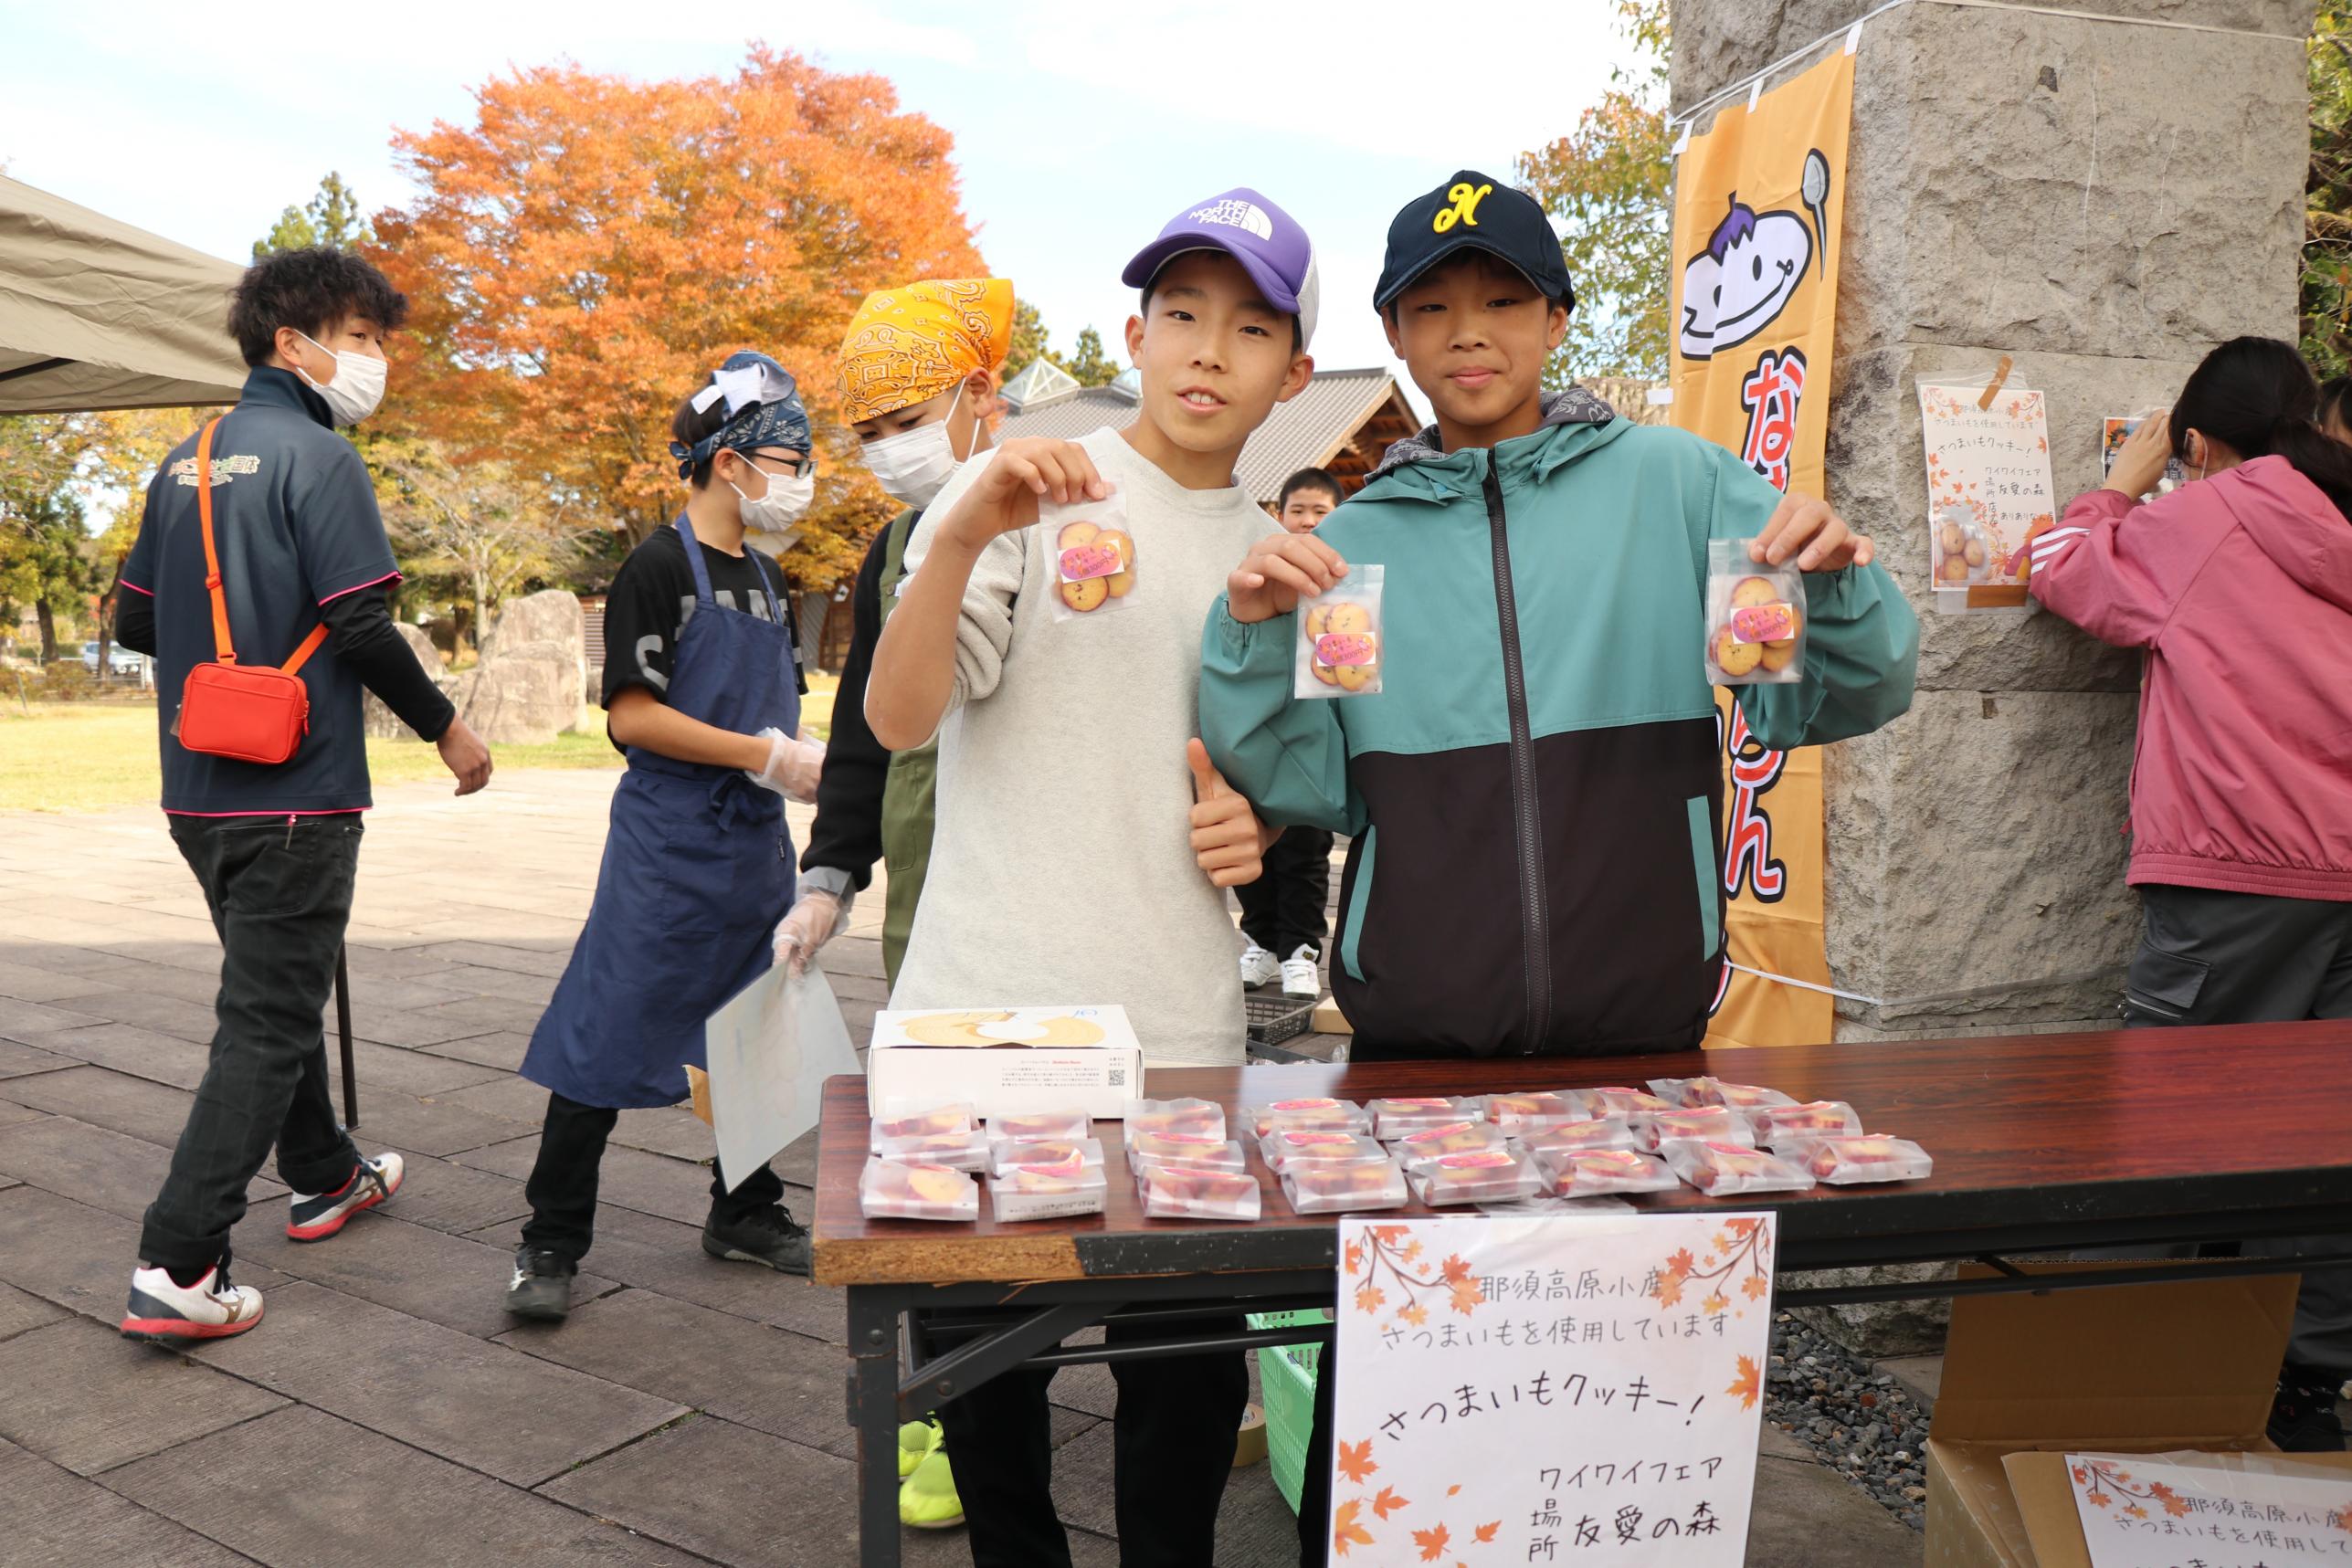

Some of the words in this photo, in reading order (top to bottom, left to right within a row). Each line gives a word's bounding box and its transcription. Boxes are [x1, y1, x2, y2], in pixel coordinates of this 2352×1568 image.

[1188, 206, 1248, 221] NORTH
[1198, 216, 1240, 227] FACE
[1218, 199, 1250, 211] THE
[1480, 1266, 1665, 1302] 那須高原小産
[1381, 1312, 1730, 1351] さつまいもを使用しています
[1379, 1370, 1705, 1441] さつまいもクッキー!
[1540, 1457, 1723, 1490] ワイワイフェア
[1574, 1500, 1722, 1548] 友愛の森
[2115, 1516, 2351, 1554] さつまいもを使用して
